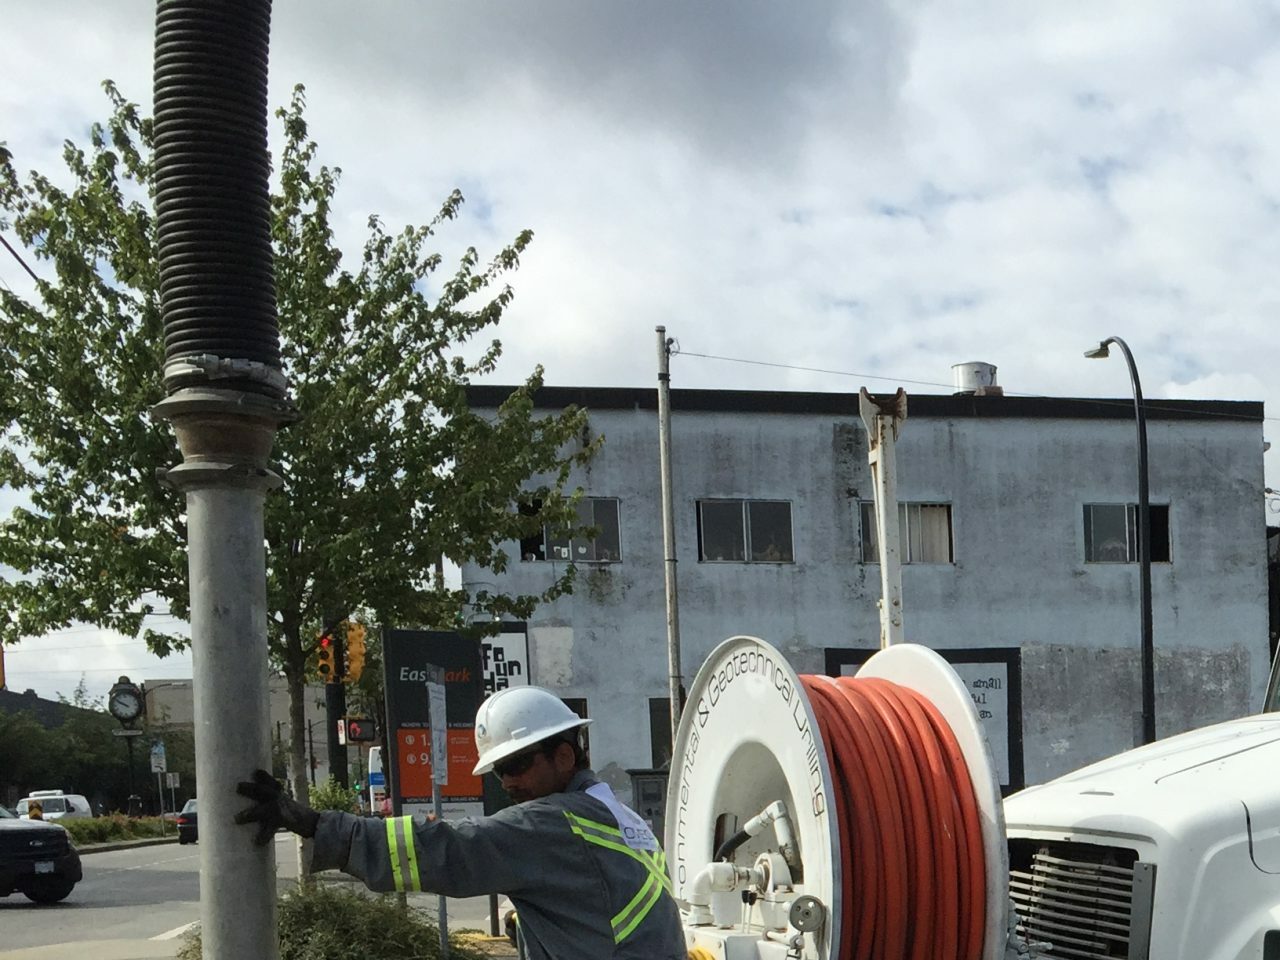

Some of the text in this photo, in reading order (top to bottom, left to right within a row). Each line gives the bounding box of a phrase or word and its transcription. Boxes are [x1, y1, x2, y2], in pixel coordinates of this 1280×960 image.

[400, 666, 470, 682] Easark
[972, 678, 1002, 690] small
[677, 645, 825, 901] ronmental & Geotechnical Drilling
